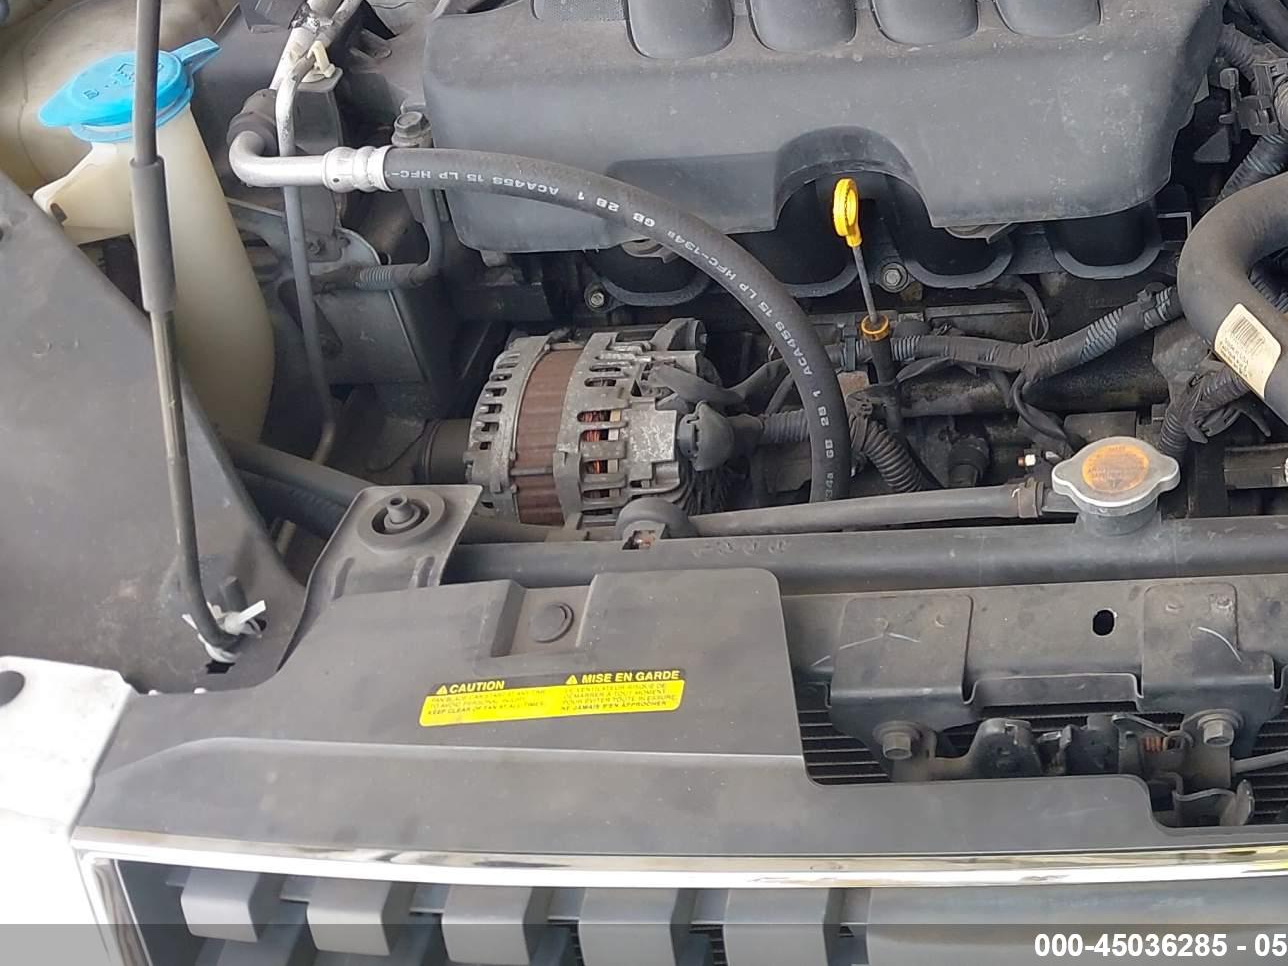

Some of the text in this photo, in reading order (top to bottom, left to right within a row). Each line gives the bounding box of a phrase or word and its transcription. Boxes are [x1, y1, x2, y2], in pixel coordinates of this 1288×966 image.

[439, 171, 459, 180] LP
[467, 174, 484, 182] 15
[739, 282, 758, 299] LP
[758, 301, 773, 318] 15
[581, 670, 680, 684] MISE EN GARDE
[449, 680, 505, 694] CAUTION
